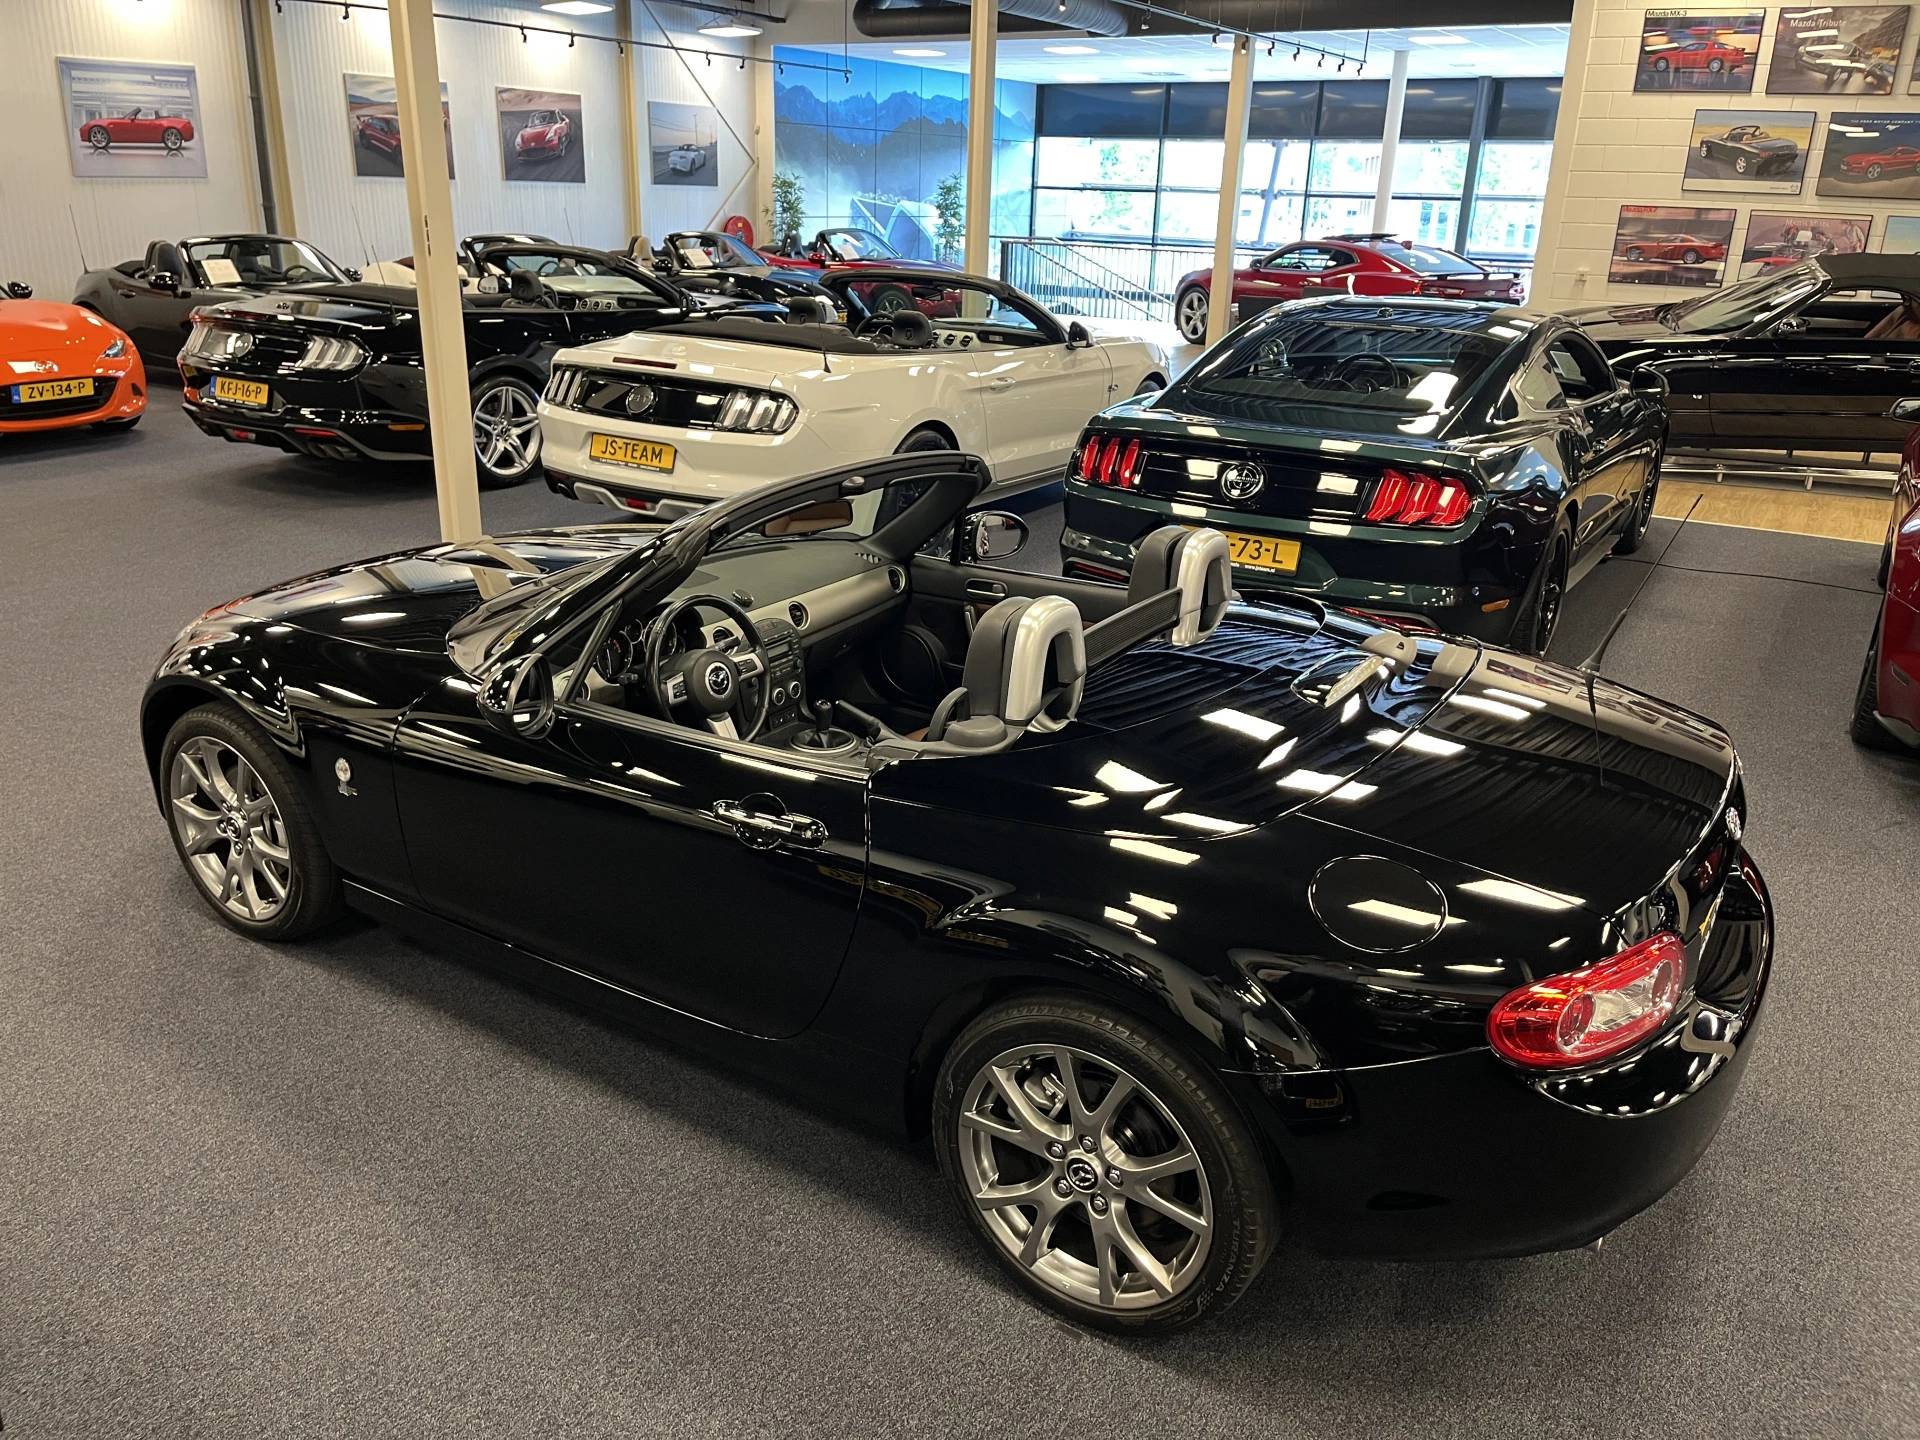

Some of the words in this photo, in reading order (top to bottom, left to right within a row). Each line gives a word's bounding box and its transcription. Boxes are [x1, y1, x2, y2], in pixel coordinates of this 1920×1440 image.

[1790, 19, 1816, 28] Mazda
[1817, 19, 1847, 28] Tribute
[28, 381, 86, 399] ZV-134-P
[220, 380, 262, 399] KFJ-16-P
[601, 439, 664, 464] JS-TEAM
[1226, 534, 1284, 564] -73-L
[1215, 1217, 1241, 1292] TURANZA
